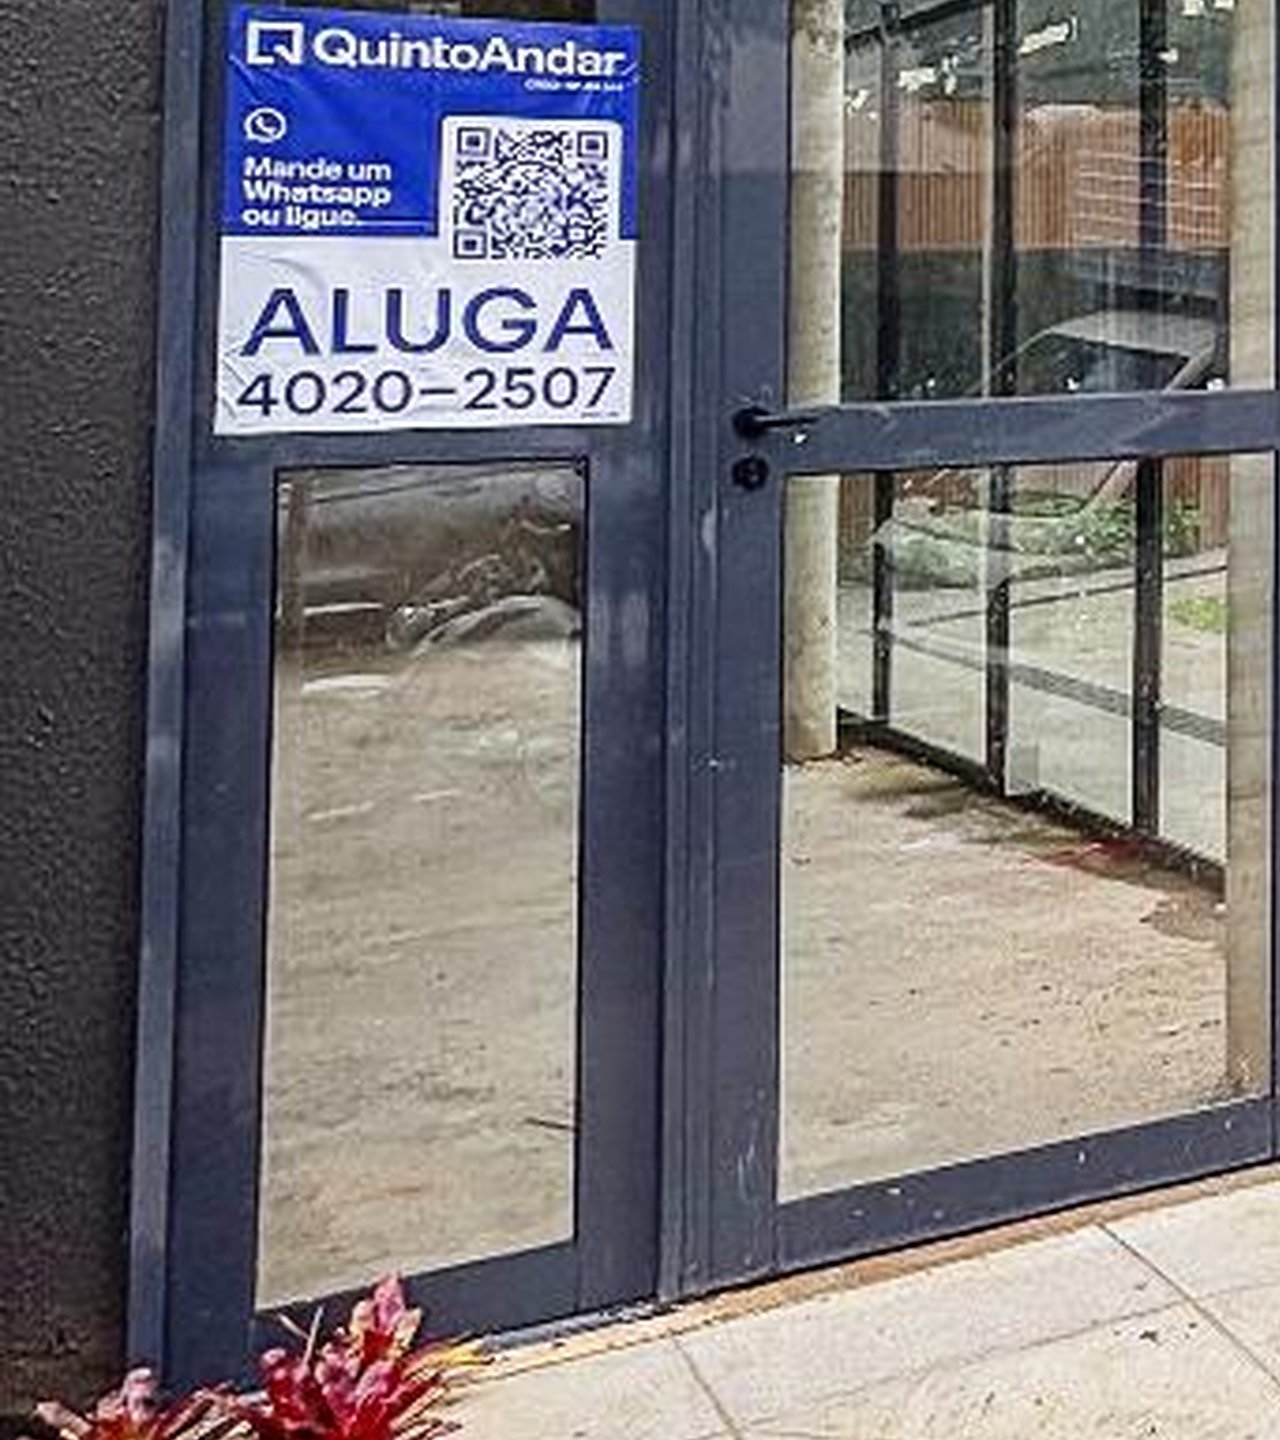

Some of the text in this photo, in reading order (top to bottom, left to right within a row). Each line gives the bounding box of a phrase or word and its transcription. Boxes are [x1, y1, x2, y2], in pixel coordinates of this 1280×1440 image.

[313, 28, 626, 76] QuintoAndar
[244, 155, 393, 182] Mande um
[242, 178, 393, 208] Whatsapp
[242, 207, 280, 227] ou
[239, 287, 615, 357] ALUGA
[236, 366, 617, 417] 4020-2507
